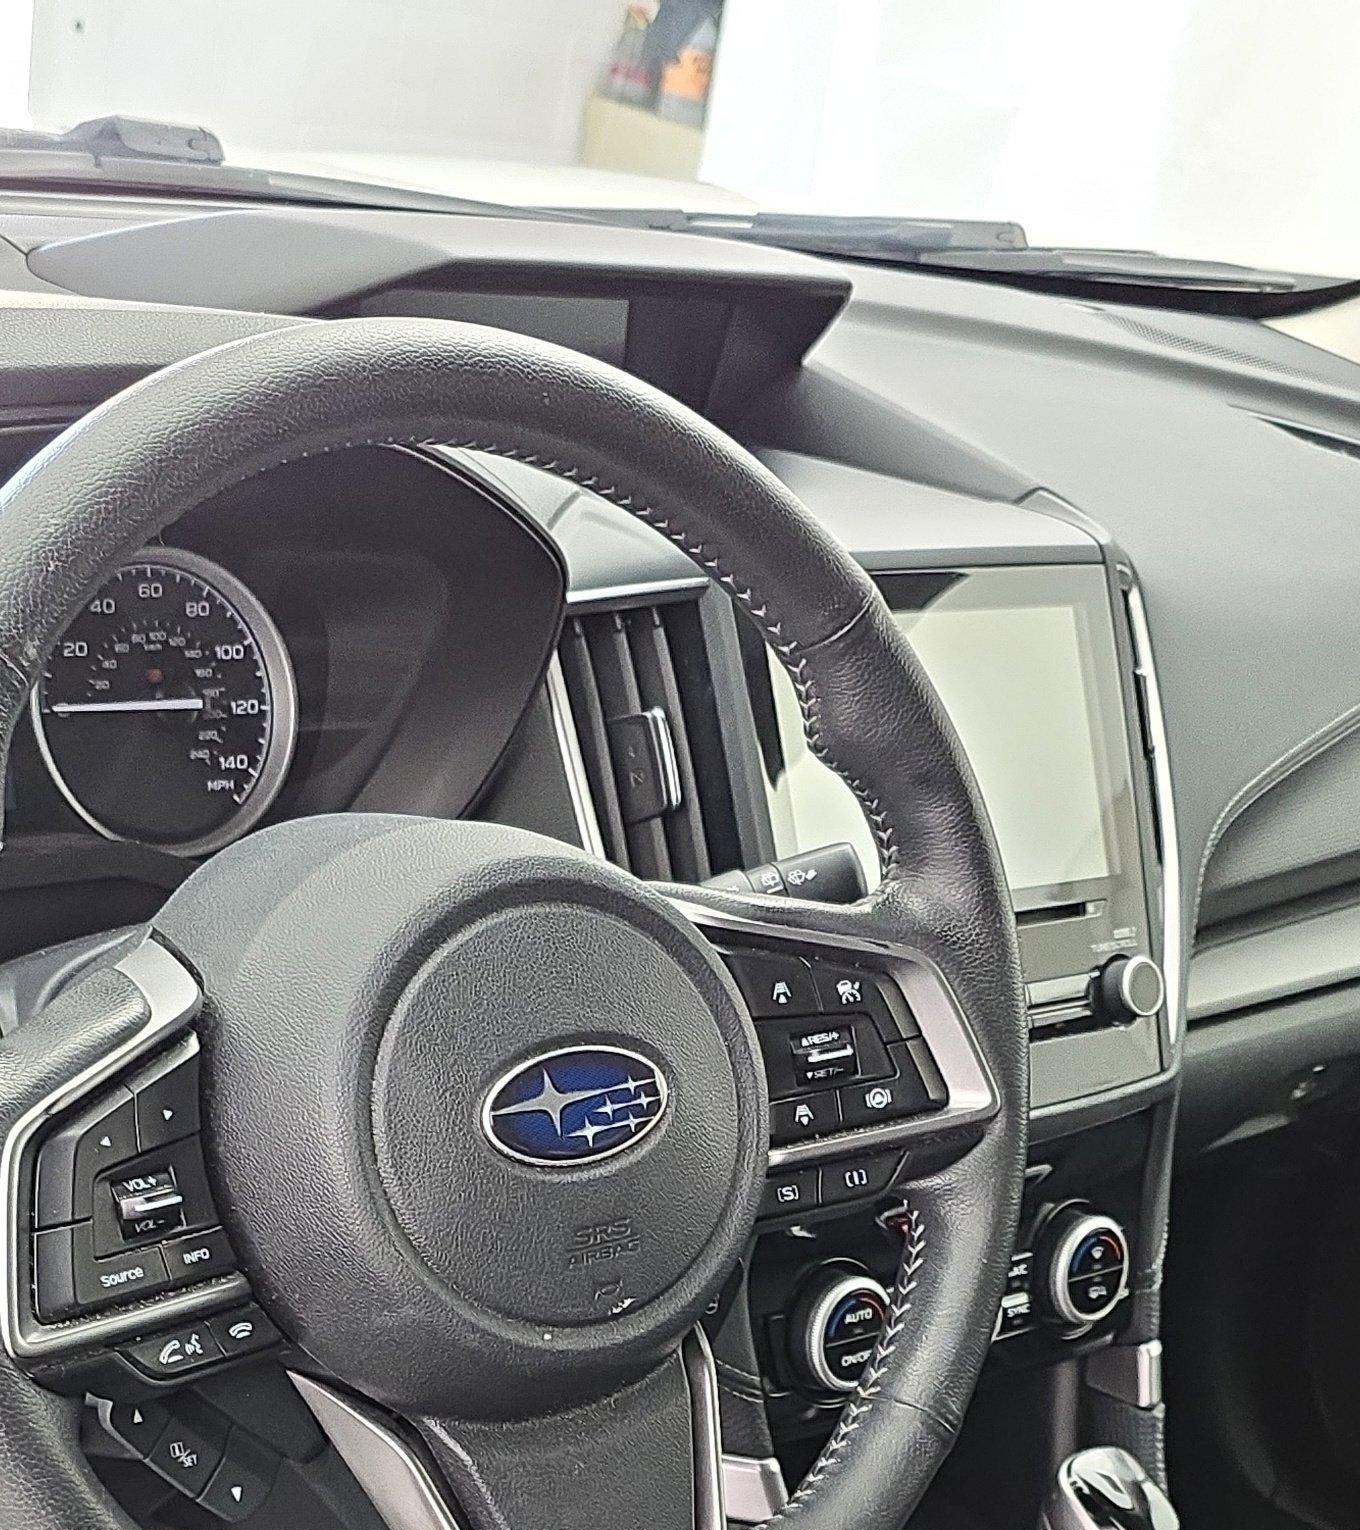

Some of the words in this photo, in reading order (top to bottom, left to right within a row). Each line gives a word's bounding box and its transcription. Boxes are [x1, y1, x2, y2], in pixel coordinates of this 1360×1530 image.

[138, 583, 163, 598] 60
[90, 599, 116, 614] 40
[185, 601, 210, 617] 80
[63, 641, 89, 657] 20
[215, 645, 245, 660] 100
[230, 700, 259, 715] 120
[219, 755, 249, 770] 140
[207, 779, 235, 792] MPH
[183, 1248, 211, 1265] INFO
[100, 1266, 145, 1288] Source
[844, 1307, 874, 1325] AUTO
